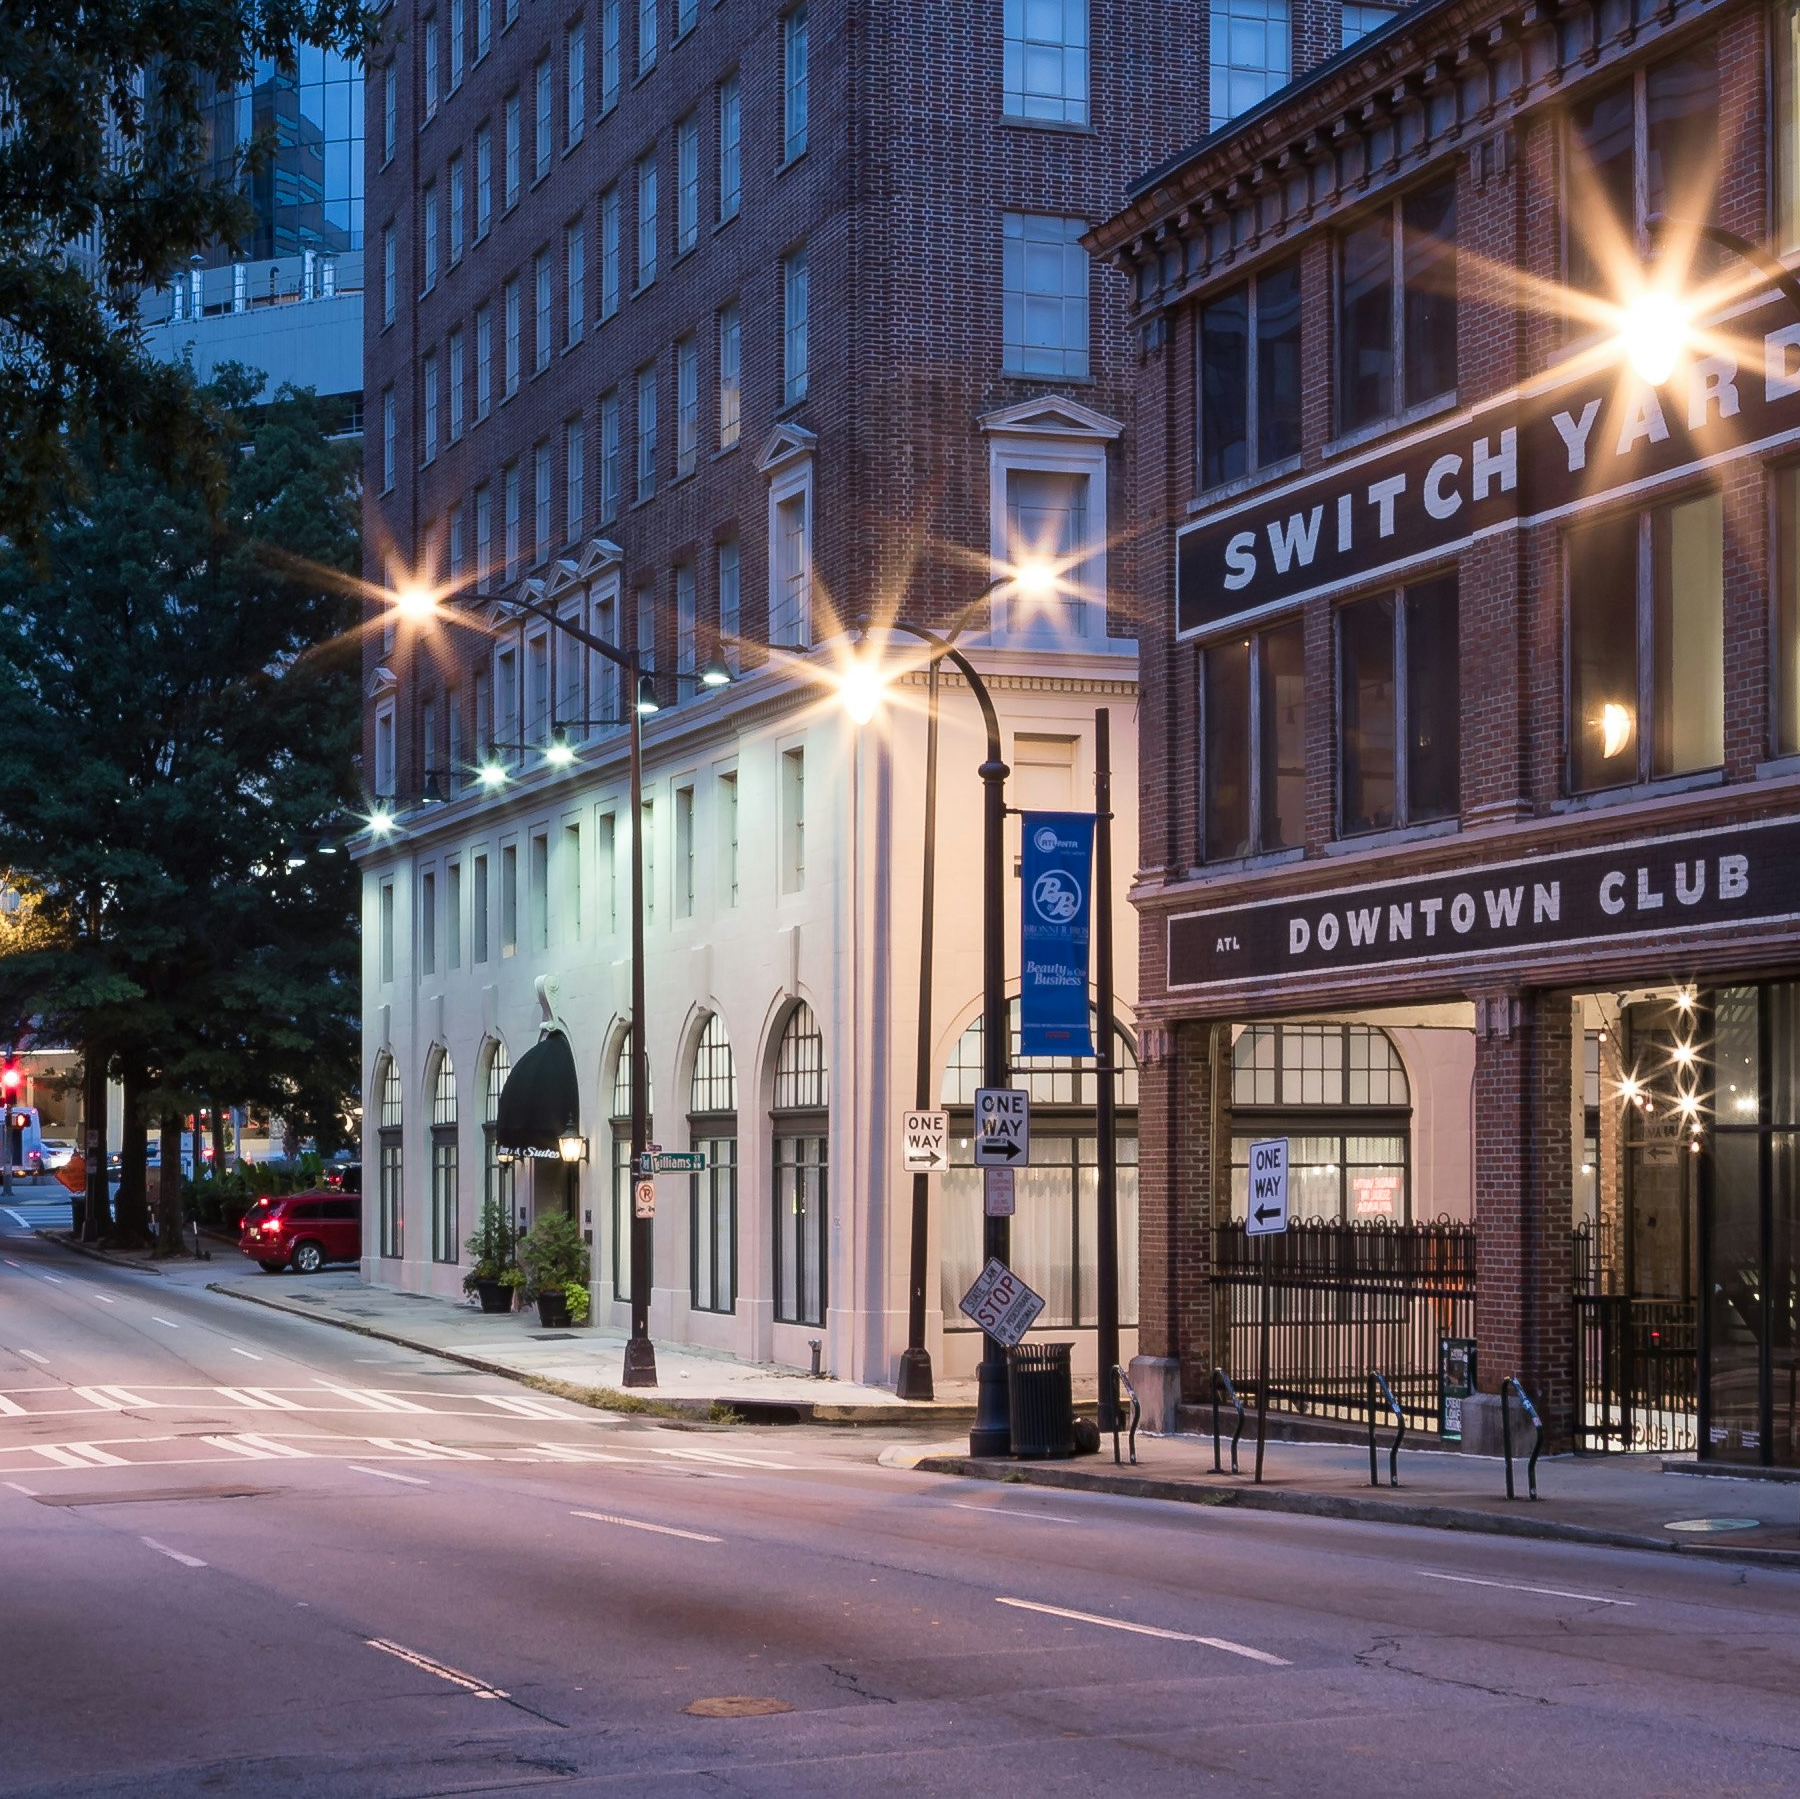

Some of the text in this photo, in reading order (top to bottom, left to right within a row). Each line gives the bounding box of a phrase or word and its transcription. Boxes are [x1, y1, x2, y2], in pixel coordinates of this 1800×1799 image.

[1222, 425, 1519, 591] SWITCH
[1041, 839, 1078, 849] ATLANTA
[1215, 936, 1241, 953] ATL
[1289, 882, 1561, 955] DOWNTOWN
[1600, 854, 1750, 916] CLUB
[1027, 961, 1067, 976] Beauty
[1034, 972, 1082, 986] Business
[982, 1096, 1023, 1114] ONE
[908, 1117, 943, 1130] ONE
[982, 1118, 1023, 1137] WAY
[908, 1135, 943, 1148] WAY
[654, 1155, 691, 1171] Williams
[1256, 1148, 1281, 1171] ONE
[1255, 1175, 1281, 1198] WAY
[966, 1285, 985, 1308] STATE
[978, 1275, 1016, 1327] STOP
